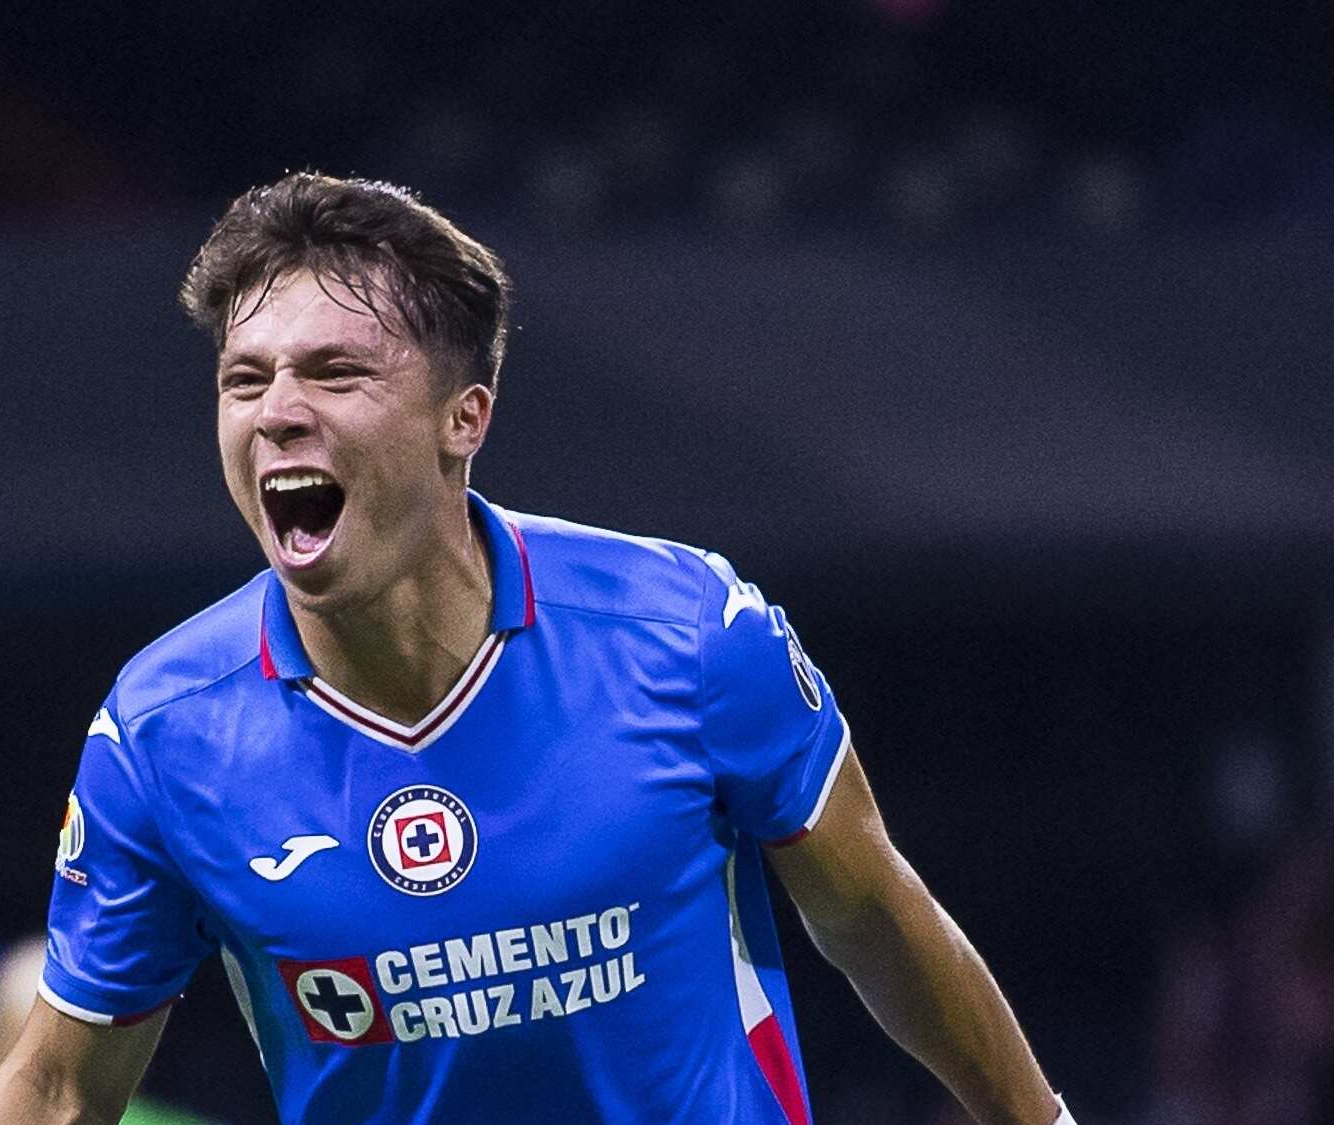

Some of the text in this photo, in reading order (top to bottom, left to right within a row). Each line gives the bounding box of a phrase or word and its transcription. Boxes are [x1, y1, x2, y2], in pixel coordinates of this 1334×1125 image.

[375, 905, 631, 994] CEMENTO
[390, 952, 646, 1042] CRUZ AZUL
